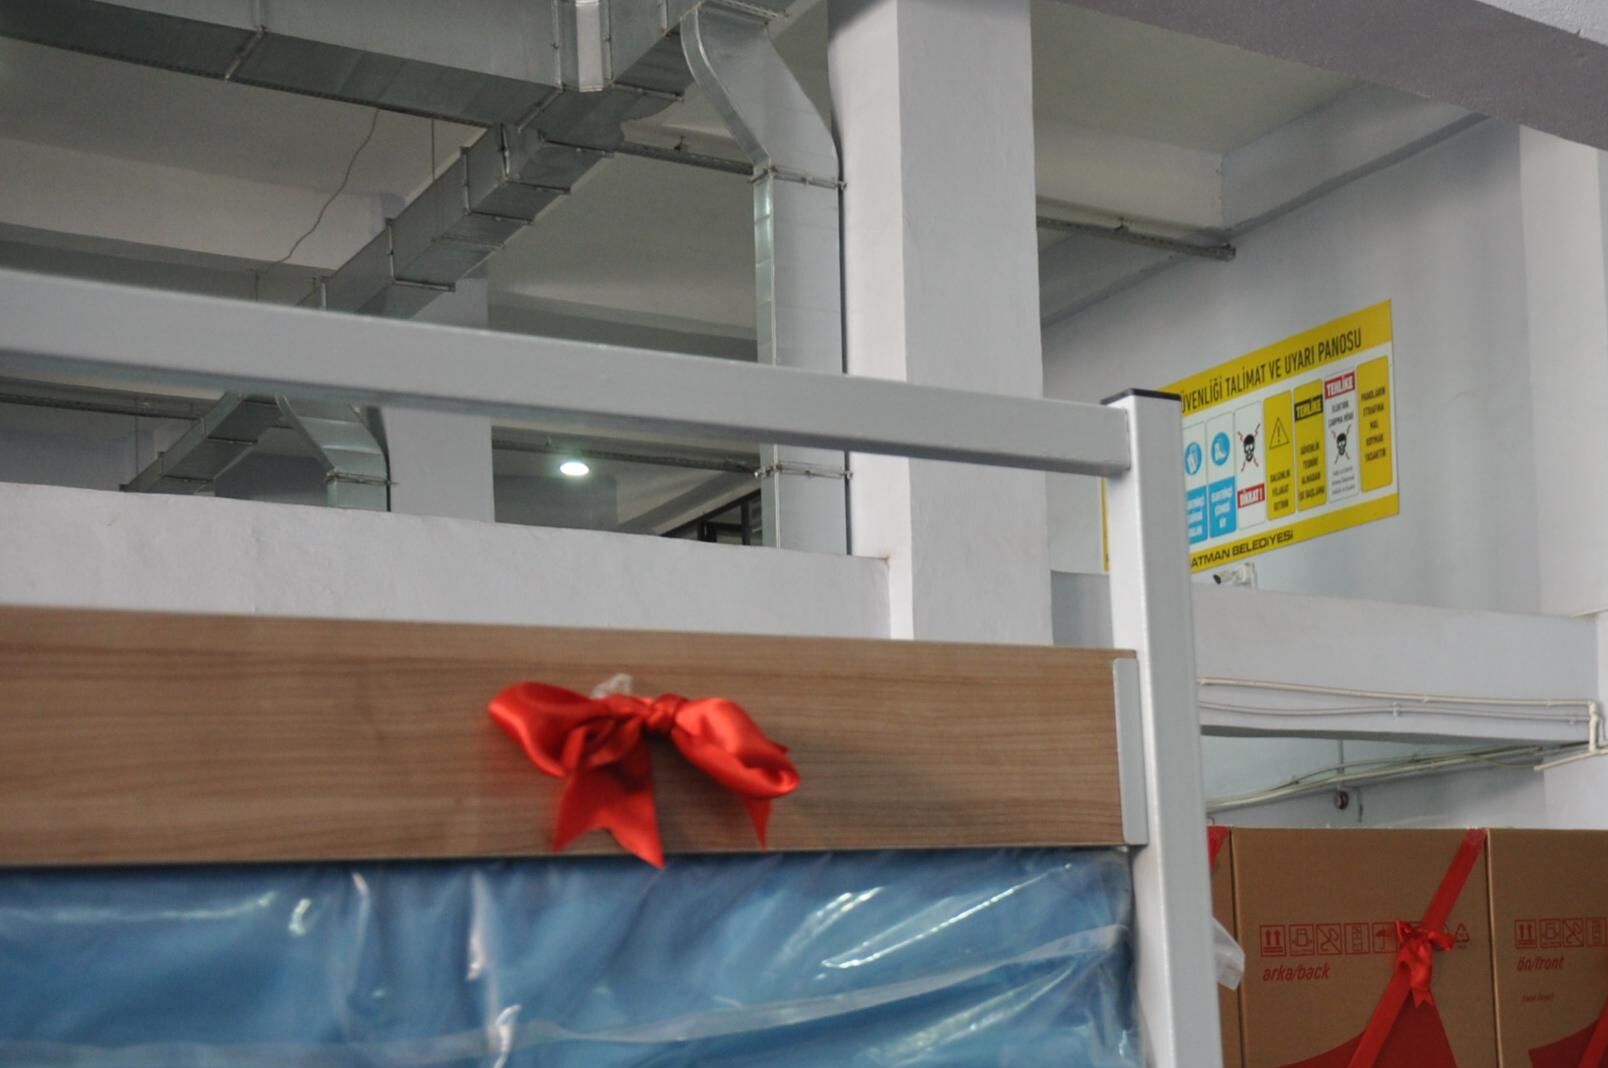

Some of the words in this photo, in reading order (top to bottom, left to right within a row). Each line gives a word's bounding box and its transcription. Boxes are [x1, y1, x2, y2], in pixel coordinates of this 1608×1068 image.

[1226, 363, 1266, 396] TALİMAT
[1268, 358, 1282, 381] VE
[1284, 347, 1315, 374] UYARI
[1318, 328, 1362, 361] PANOSU
[1191, 548, 1231, 568] ATMAN
[1263, 962, 1331, 982] arka/back
